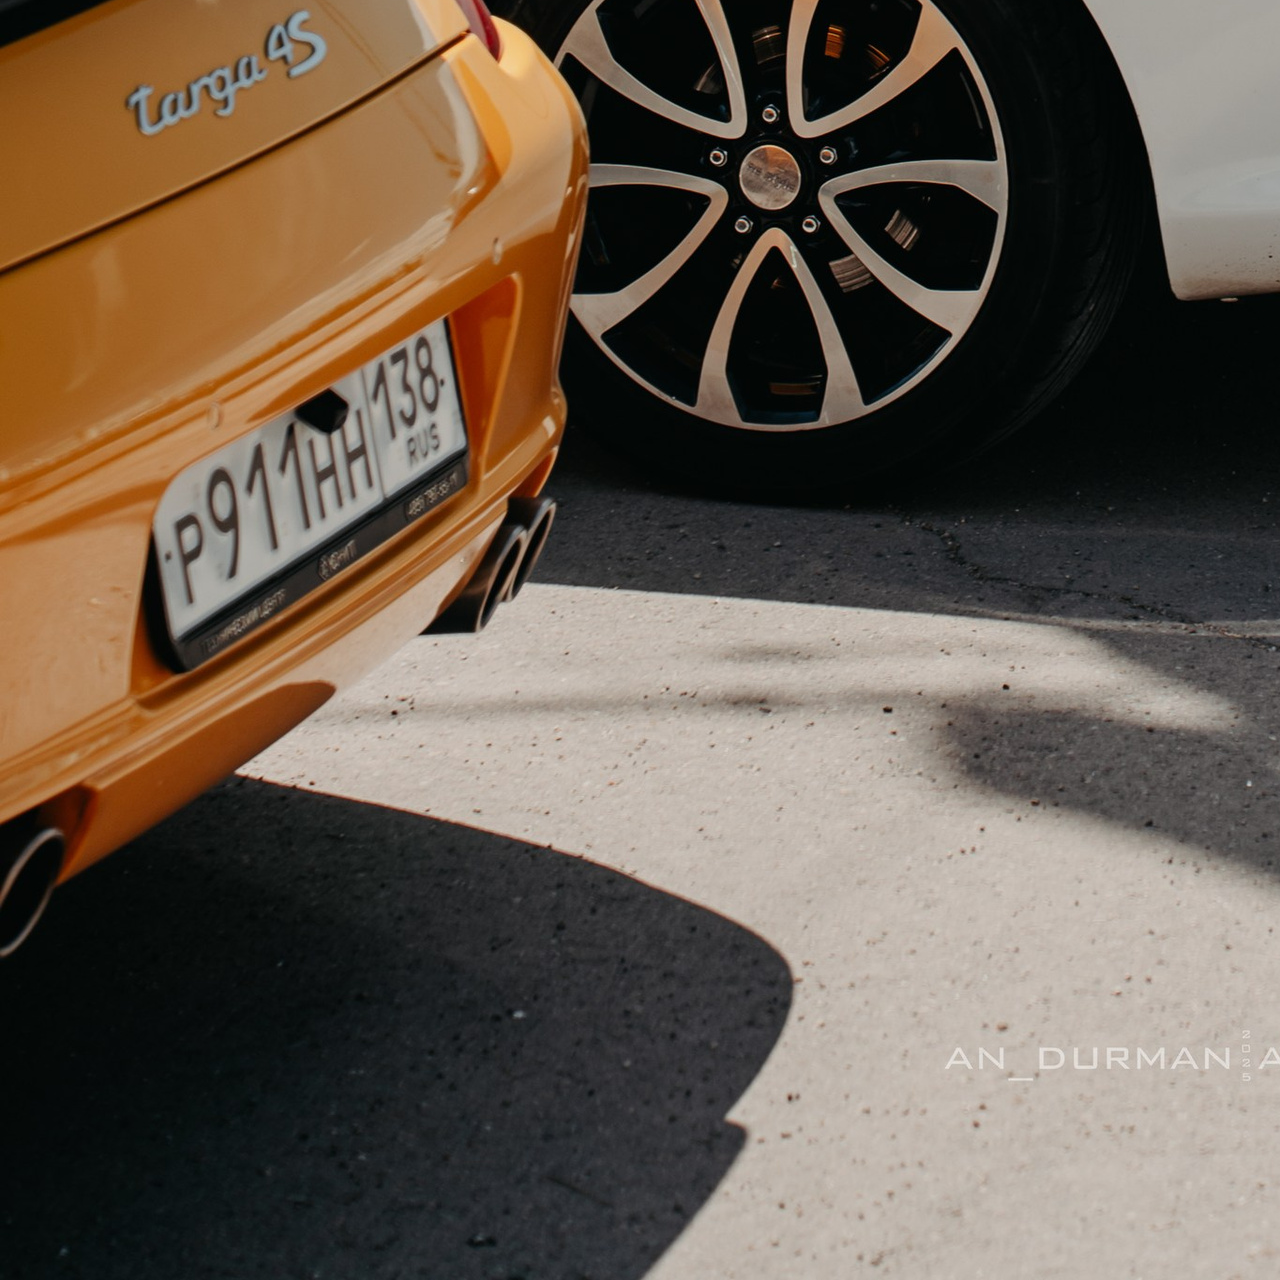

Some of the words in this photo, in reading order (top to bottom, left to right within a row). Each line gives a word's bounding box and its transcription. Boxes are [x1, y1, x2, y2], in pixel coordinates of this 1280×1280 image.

[264, 10, 328, 79] 4S
[371, 335, 441, 441] 138
[406, 423, 441, 466] RUS
